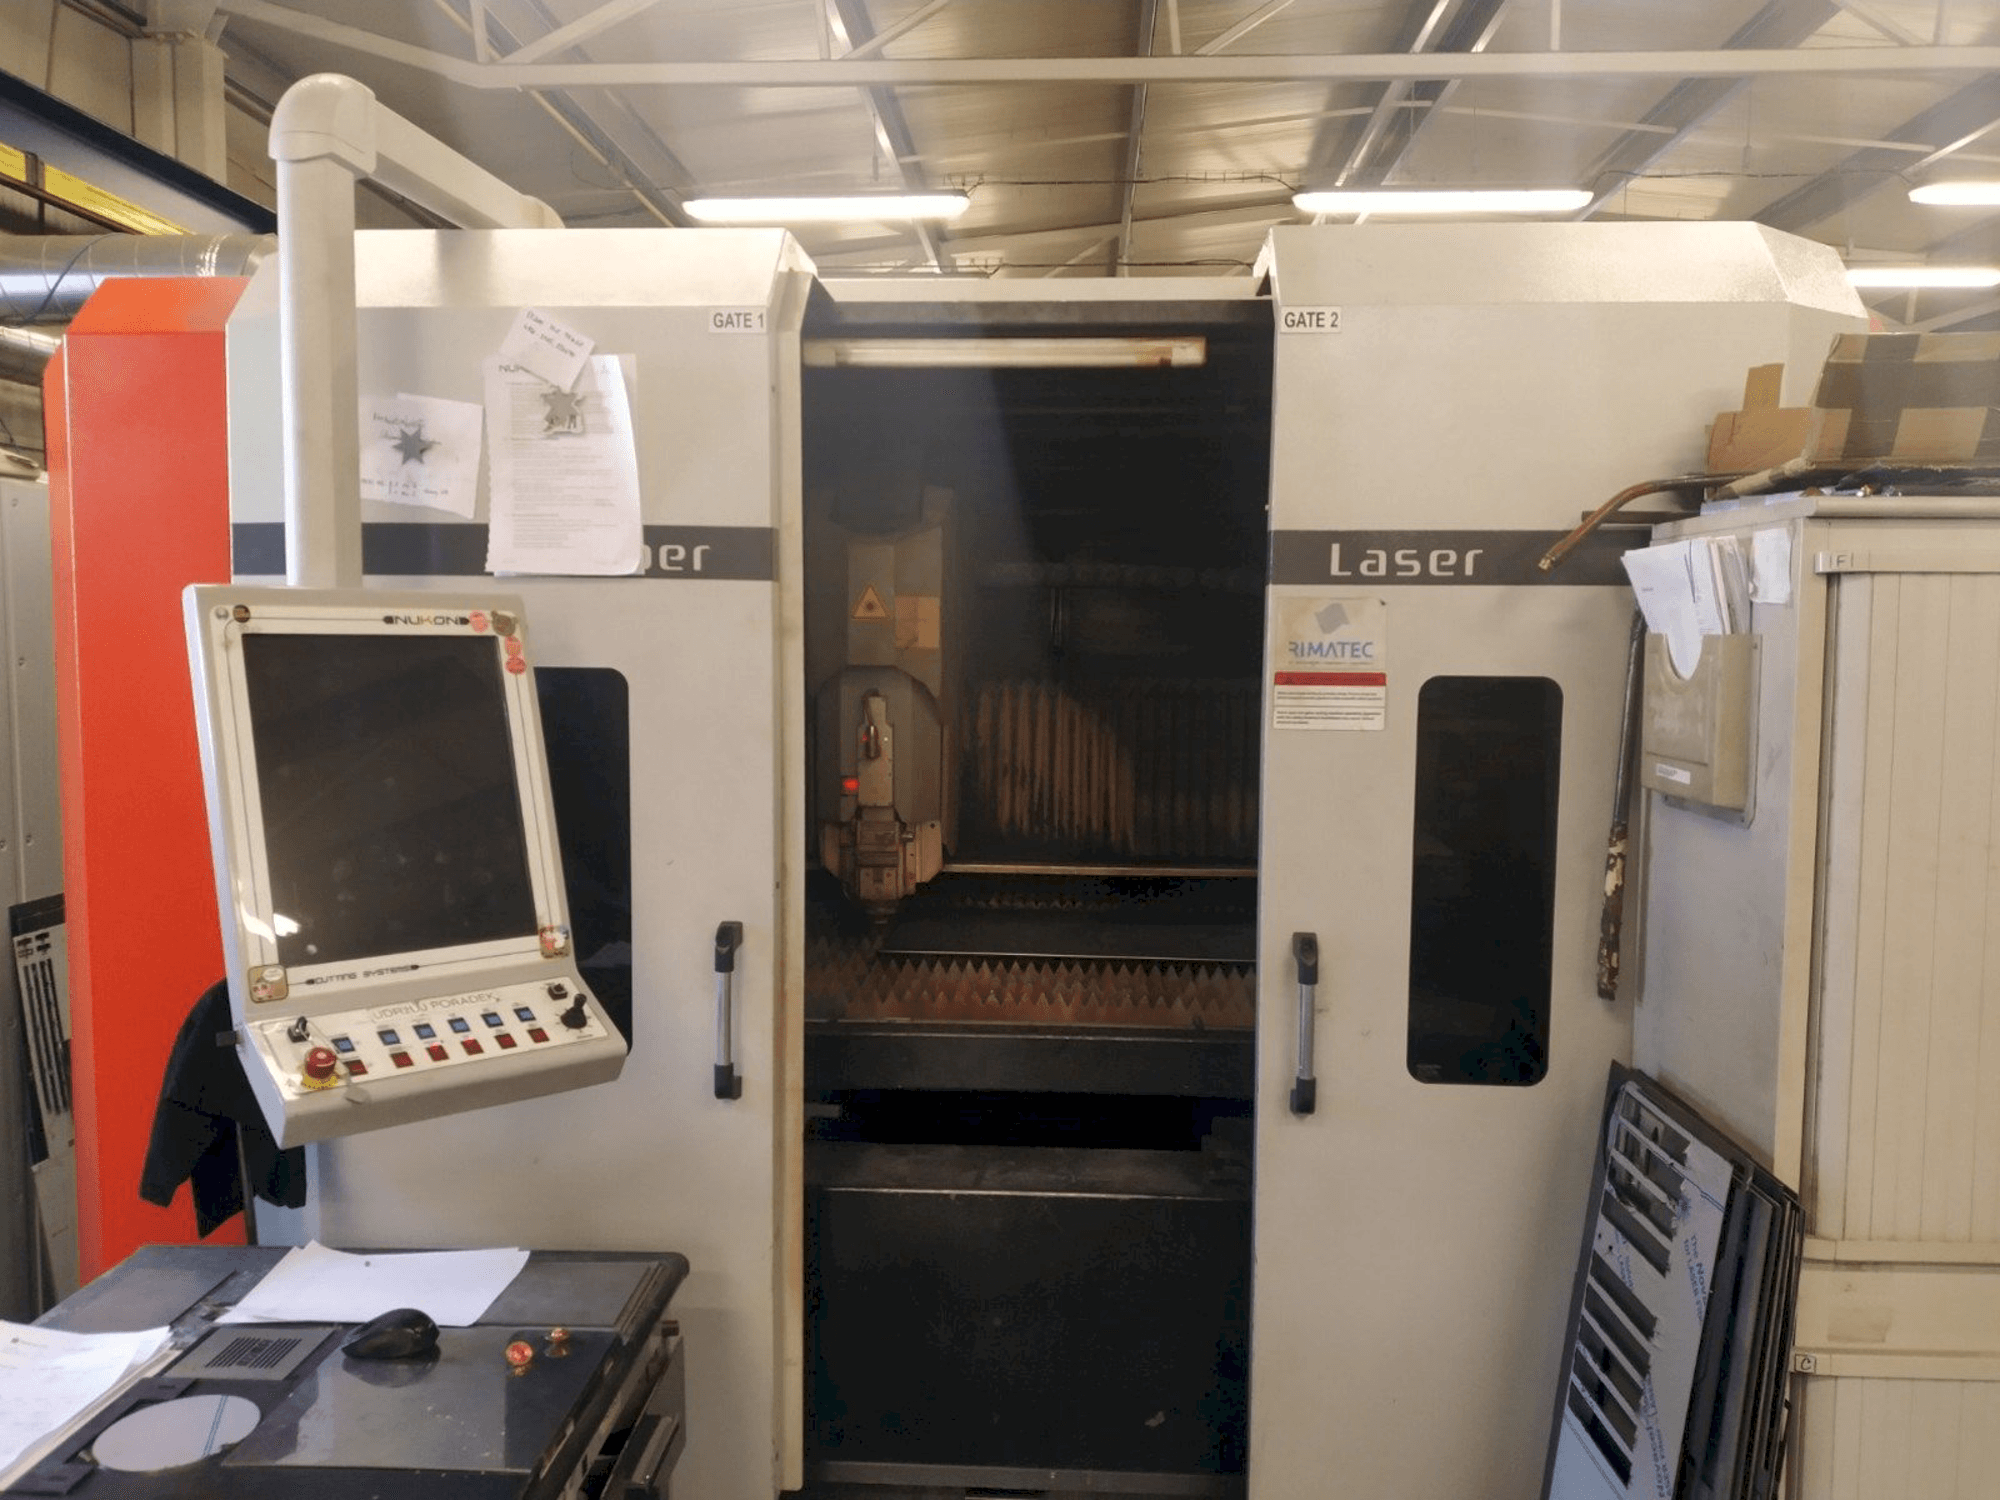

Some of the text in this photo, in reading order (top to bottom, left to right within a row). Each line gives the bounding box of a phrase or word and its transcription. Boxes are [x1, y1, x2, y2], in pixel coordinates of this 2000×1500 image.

[713, 312, 764, 328] GATE 1
[1284, 312, 1339, 328] GATE 2
[1330, 543, 1483, 576] Laser
[394, 615, 461, 626] NUKON
[1288, 641, 1373, 658] RIMATEC
[315, 971, 357, 985] CUTTING
